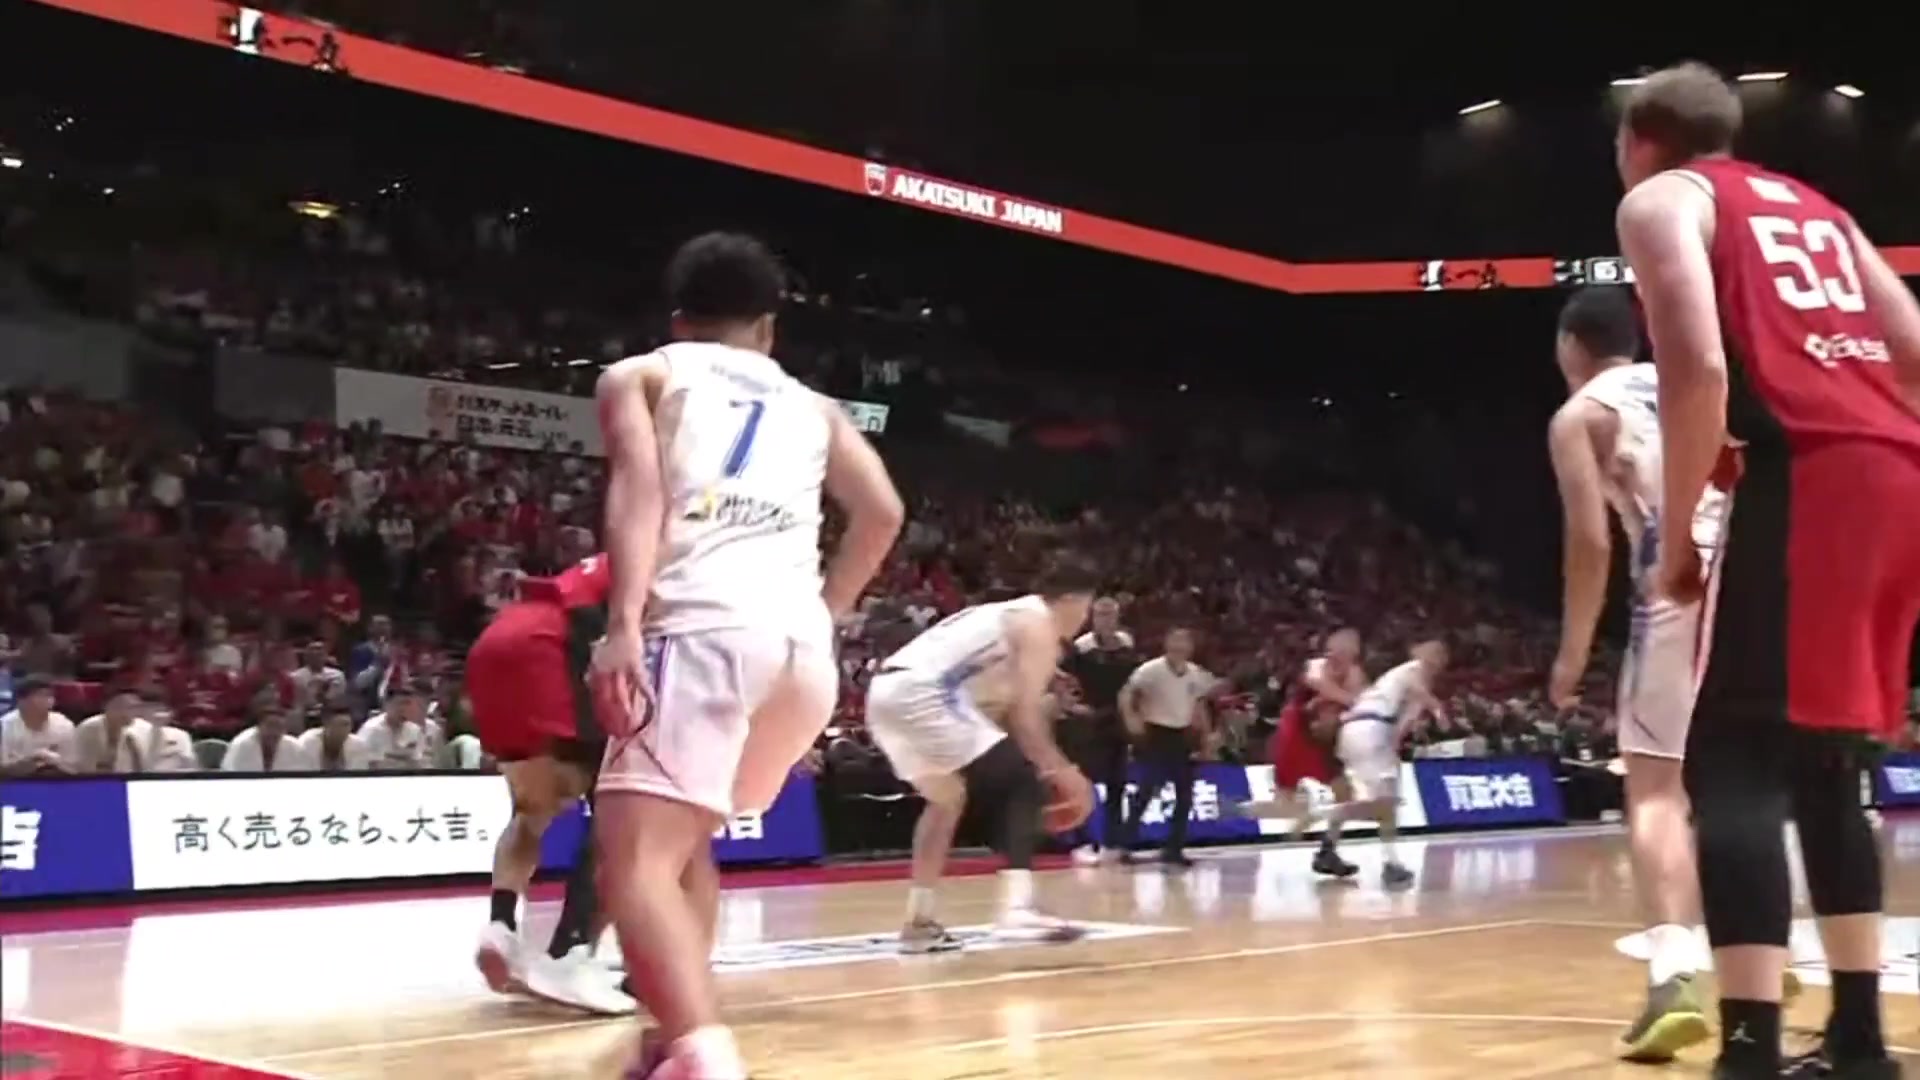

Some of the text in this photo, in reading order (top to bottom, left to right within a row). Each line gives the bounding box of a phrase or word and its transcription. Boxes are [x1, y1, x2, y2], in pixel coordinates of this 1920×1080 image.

[892, 174, 996, 218] AKATSUKI
[1000, 200, 1062, 233] JAPAN
[1747, 215, 1866, 312] 53
[728, 400, 765, 478] 7
